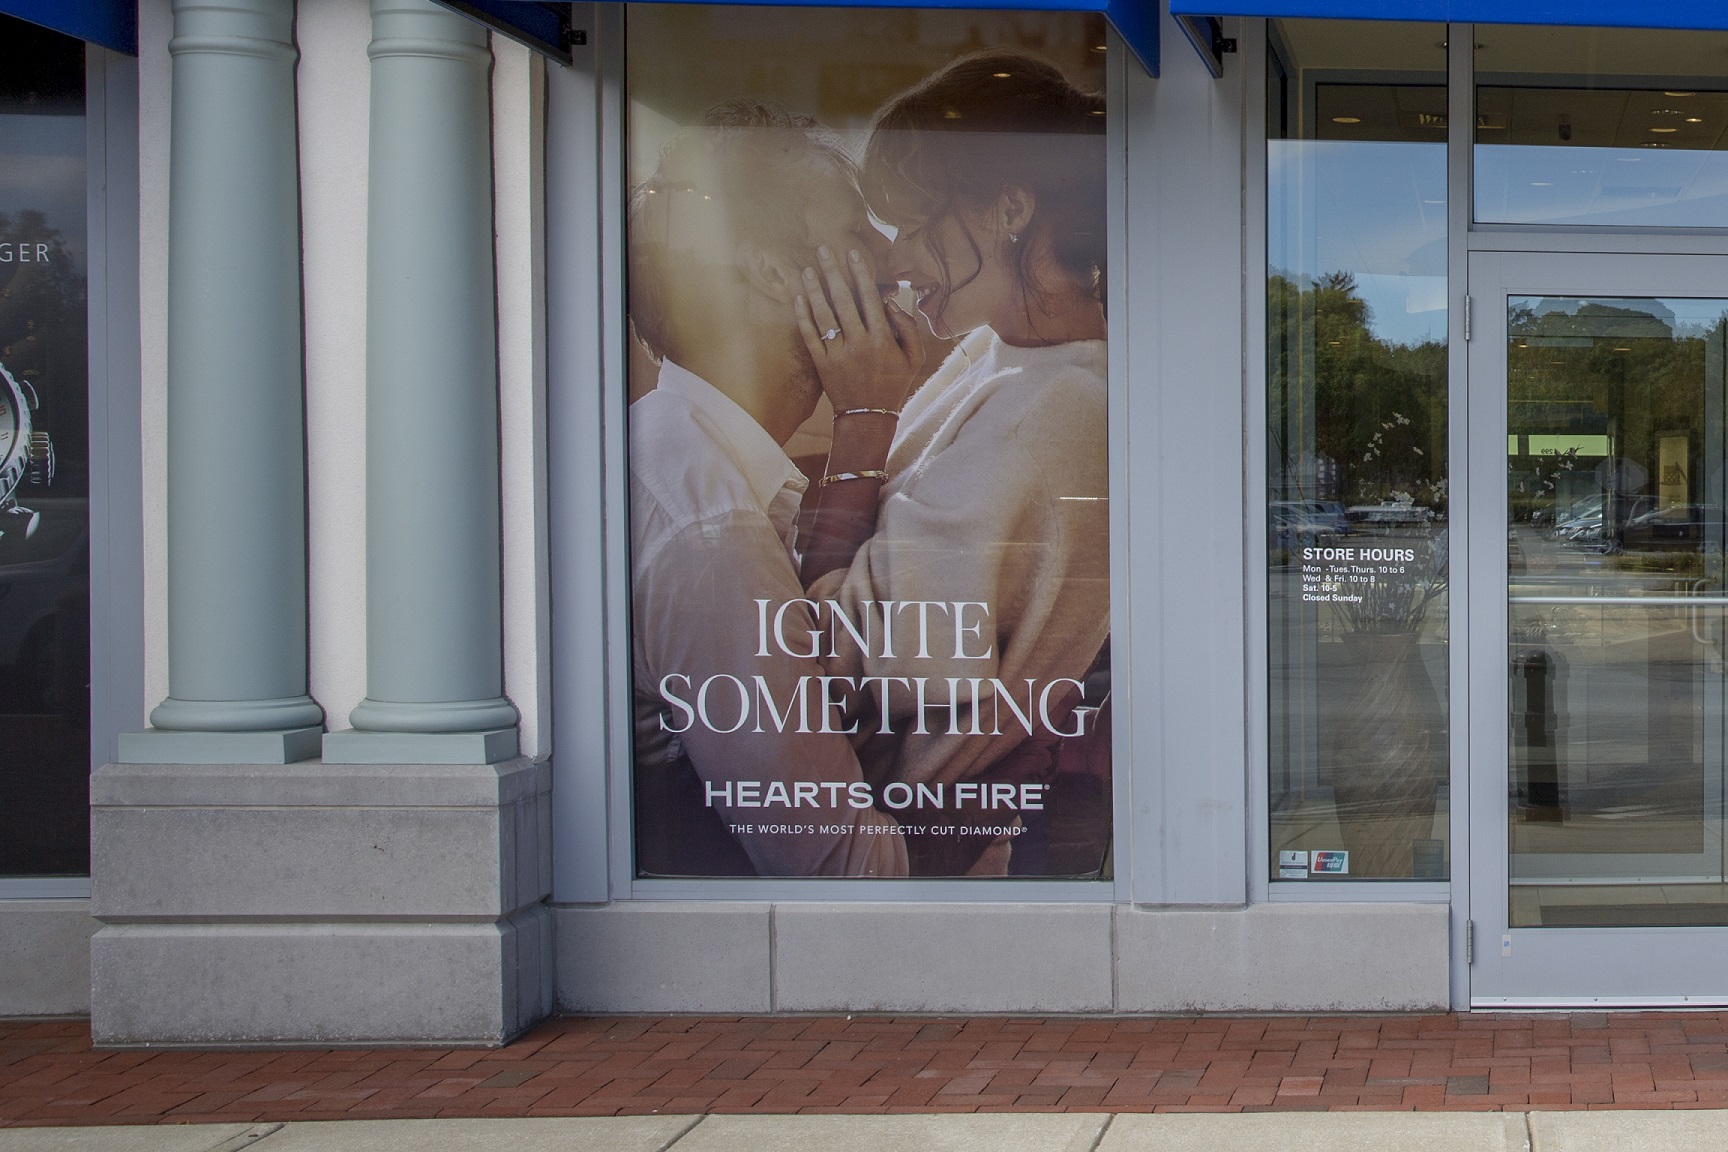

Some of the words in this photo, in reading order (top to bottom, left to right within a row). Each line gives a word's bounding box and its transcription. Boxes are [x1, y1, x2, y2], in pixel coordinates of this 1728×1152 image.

[1303, 548, 1354, 560] STORE
[1360, 549, 1414, 561] HOURS
[1303, 565, 1321, 573] Mon
[1332, 594, 1362, 603] Sunday
[754, 598, 993, 660] IGNITE
[659, 673, 1088, 737] SOMETHING
[704, 781, 873, 809] HEARTS
[883, 782, 944, 810] ON
[730, 824, 753, 834] THE
[820, 825, 854, 835] MOST
[860, 825, 925, 836] PERFECTLY
[931, 826, 955, 836] CUT
